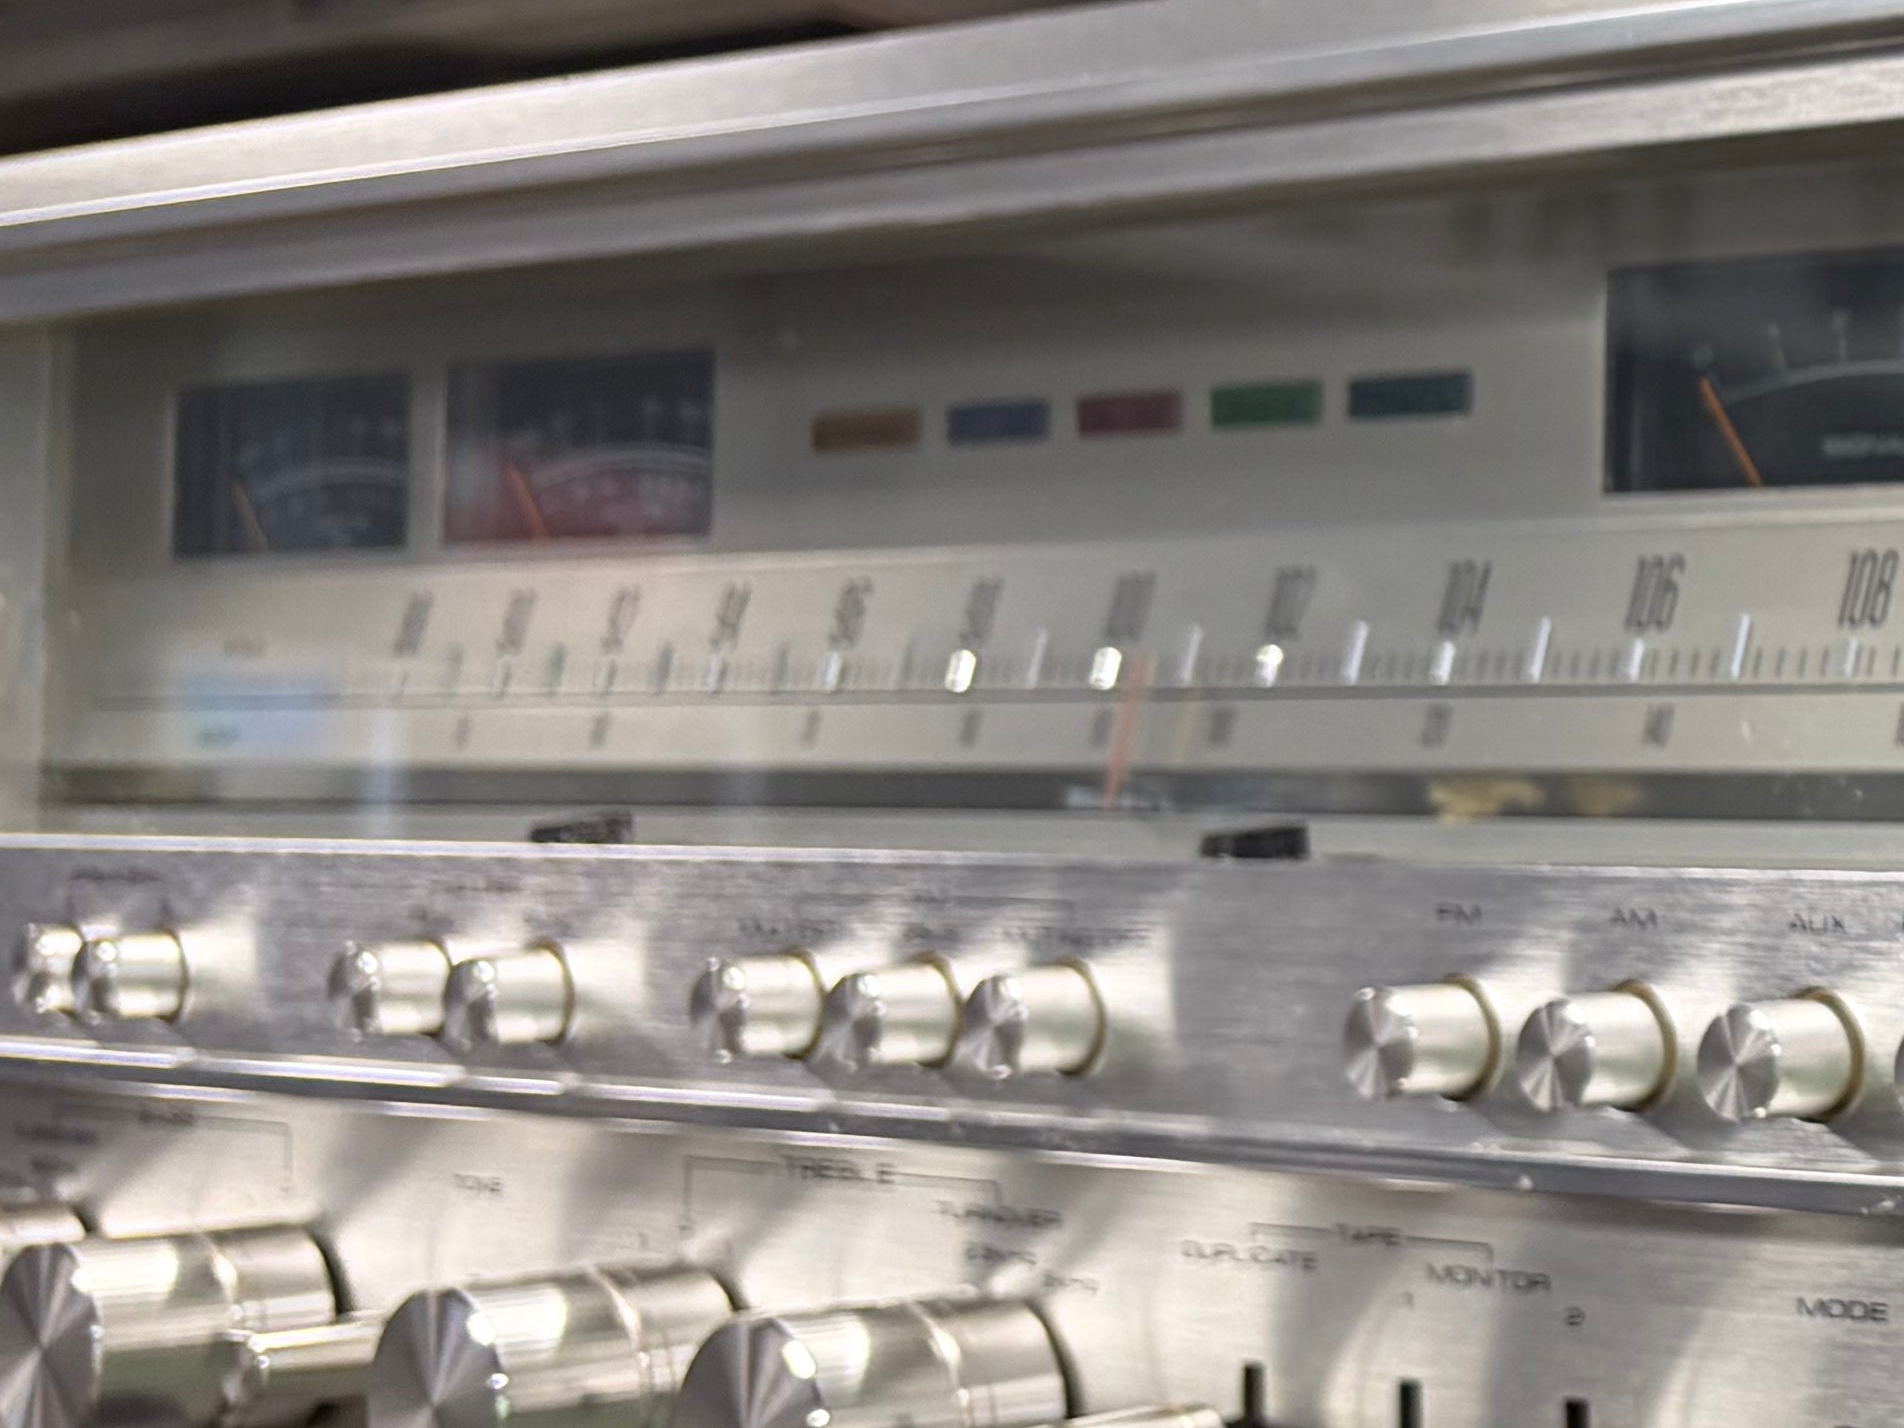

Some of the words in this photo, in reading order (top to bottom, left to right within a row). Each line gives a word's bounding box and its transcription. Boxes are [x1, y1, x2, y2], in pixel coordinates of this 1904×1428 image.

[1624, 553, 1687, 633] 106
[1837, 547, 1900, 629] 108
[1609, 907, 1659, 930] AM
[1789, 911, 1846, 934] AUX
[1180, 1238, 1319, 1272] DUPLICATE
[1425, 1262, 1553, 1293] MONITOR
[1797, 1296, 1890, 1323] MODE
